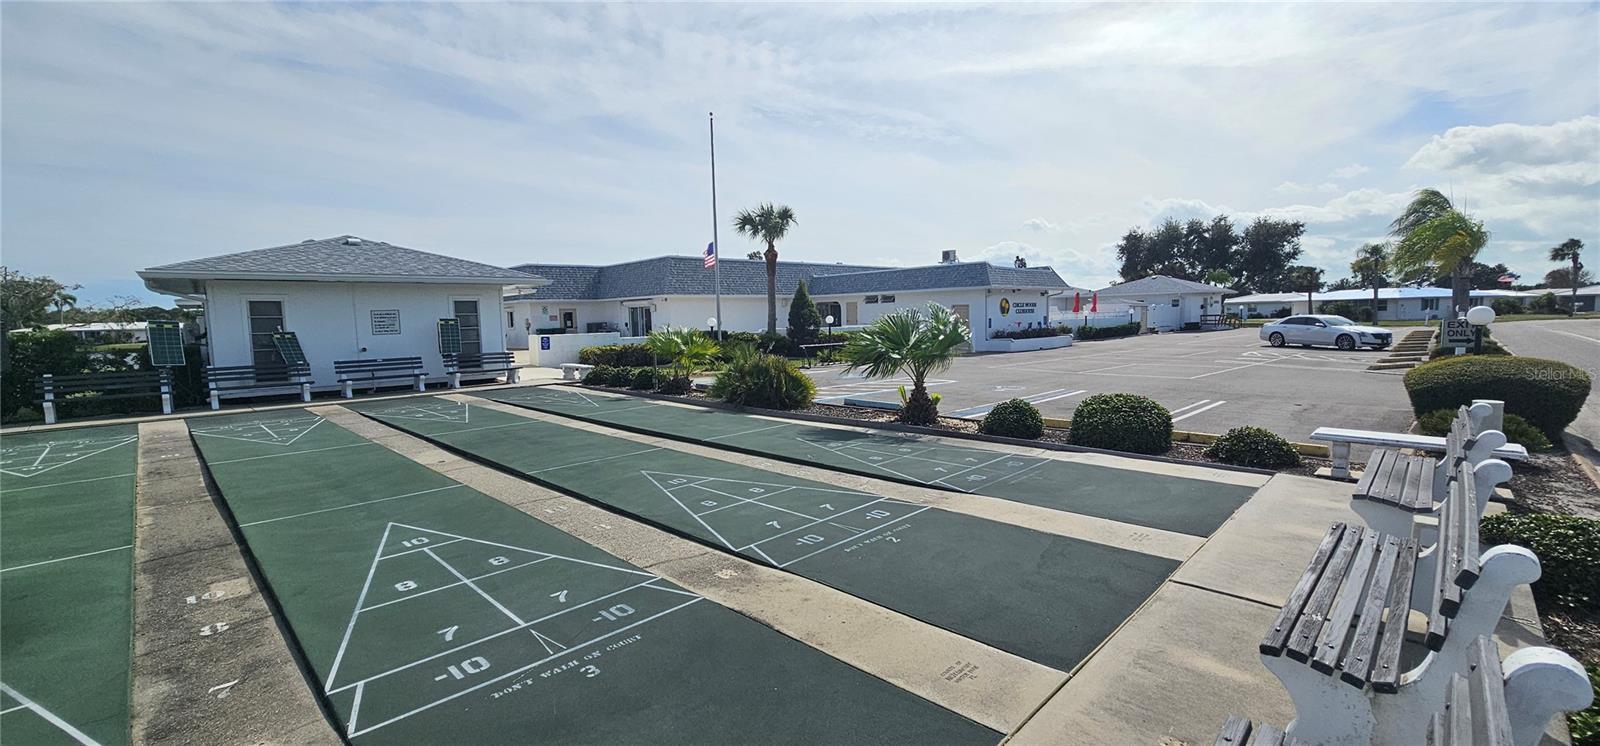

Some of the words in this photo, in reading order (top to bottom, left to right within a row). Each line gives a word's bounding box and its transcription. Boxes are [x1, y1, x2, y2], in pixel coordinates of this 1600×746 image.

[1447, 320, 1477, 329] EXI
[1447, 329, 1478, 337] ONLY
[819, 503, 836, 511] 7
[766, 520, 782, 529] 7
[401, 537, 430, 548] 10
[488, 556, 511, 566] 8
[394, 580, 418, 592] 8
[550, 590, 569, 603] 7
[591, 603, 636, 623] -10
[436, 625, 459, 642] 7
[434, 656, 491, 682] -10
[539, 659, 580, 678] WALK
[583, 650, 602, 661] ON
[579, 664, 601, 678] 3
